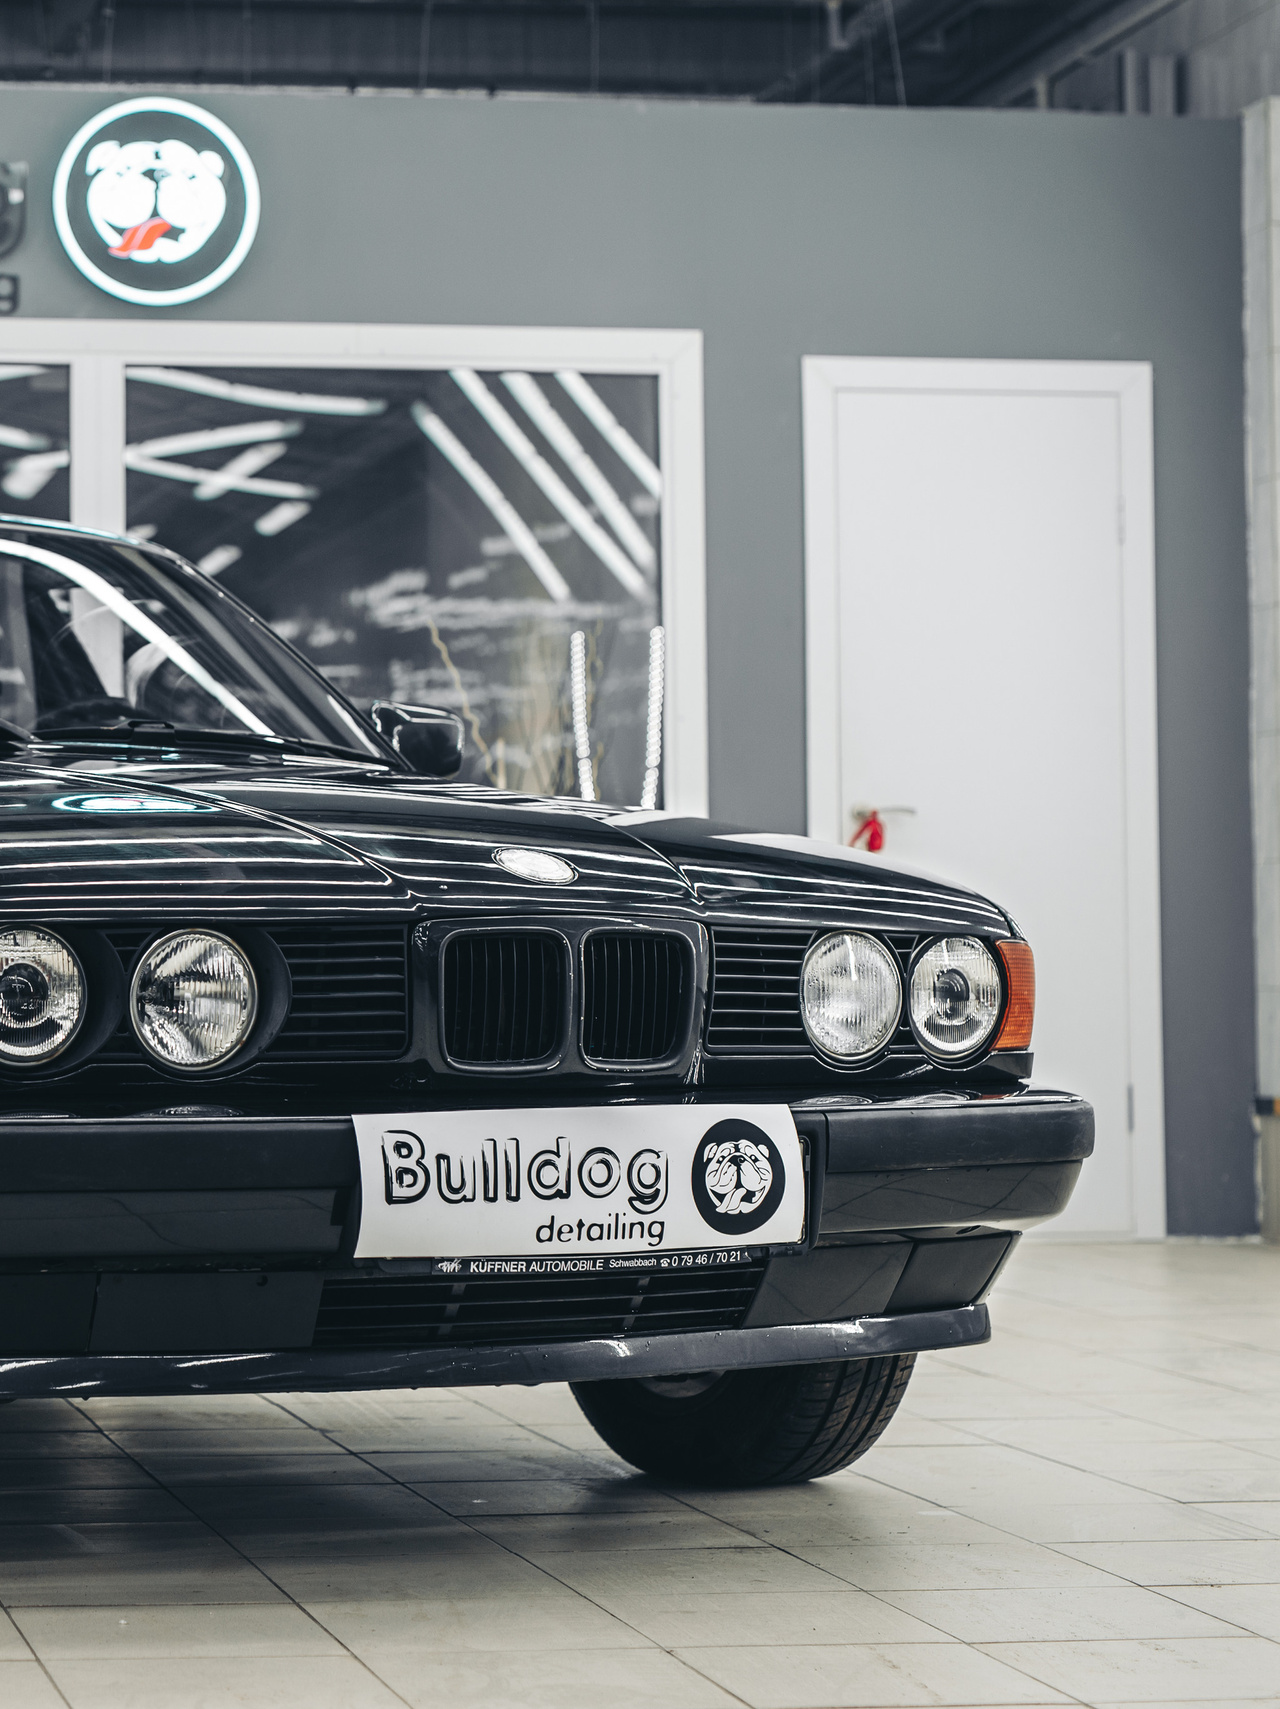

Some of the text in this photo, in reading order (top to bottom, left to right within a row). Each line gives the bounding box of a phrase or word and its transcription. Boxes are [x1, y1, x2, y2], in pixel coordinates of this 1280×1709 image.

[381, 1129, 669, 1214] Bulldog
[535, 1212, 666, 1246] detailing
[470, 1259, 527, 1273] KÜFFNER
[528, 1259, 605, 1272] AUTOMOBILE
[608, 1257, 657, 1268] Schwabbach
[671, 1255, 679, 1267] 0
[681, 1254, 694, 1266] 79
[695, 1253, 708, 1265] 46
[716, 1252, 728, 1263] 70
[730, 1251, 741, 1262] 21
